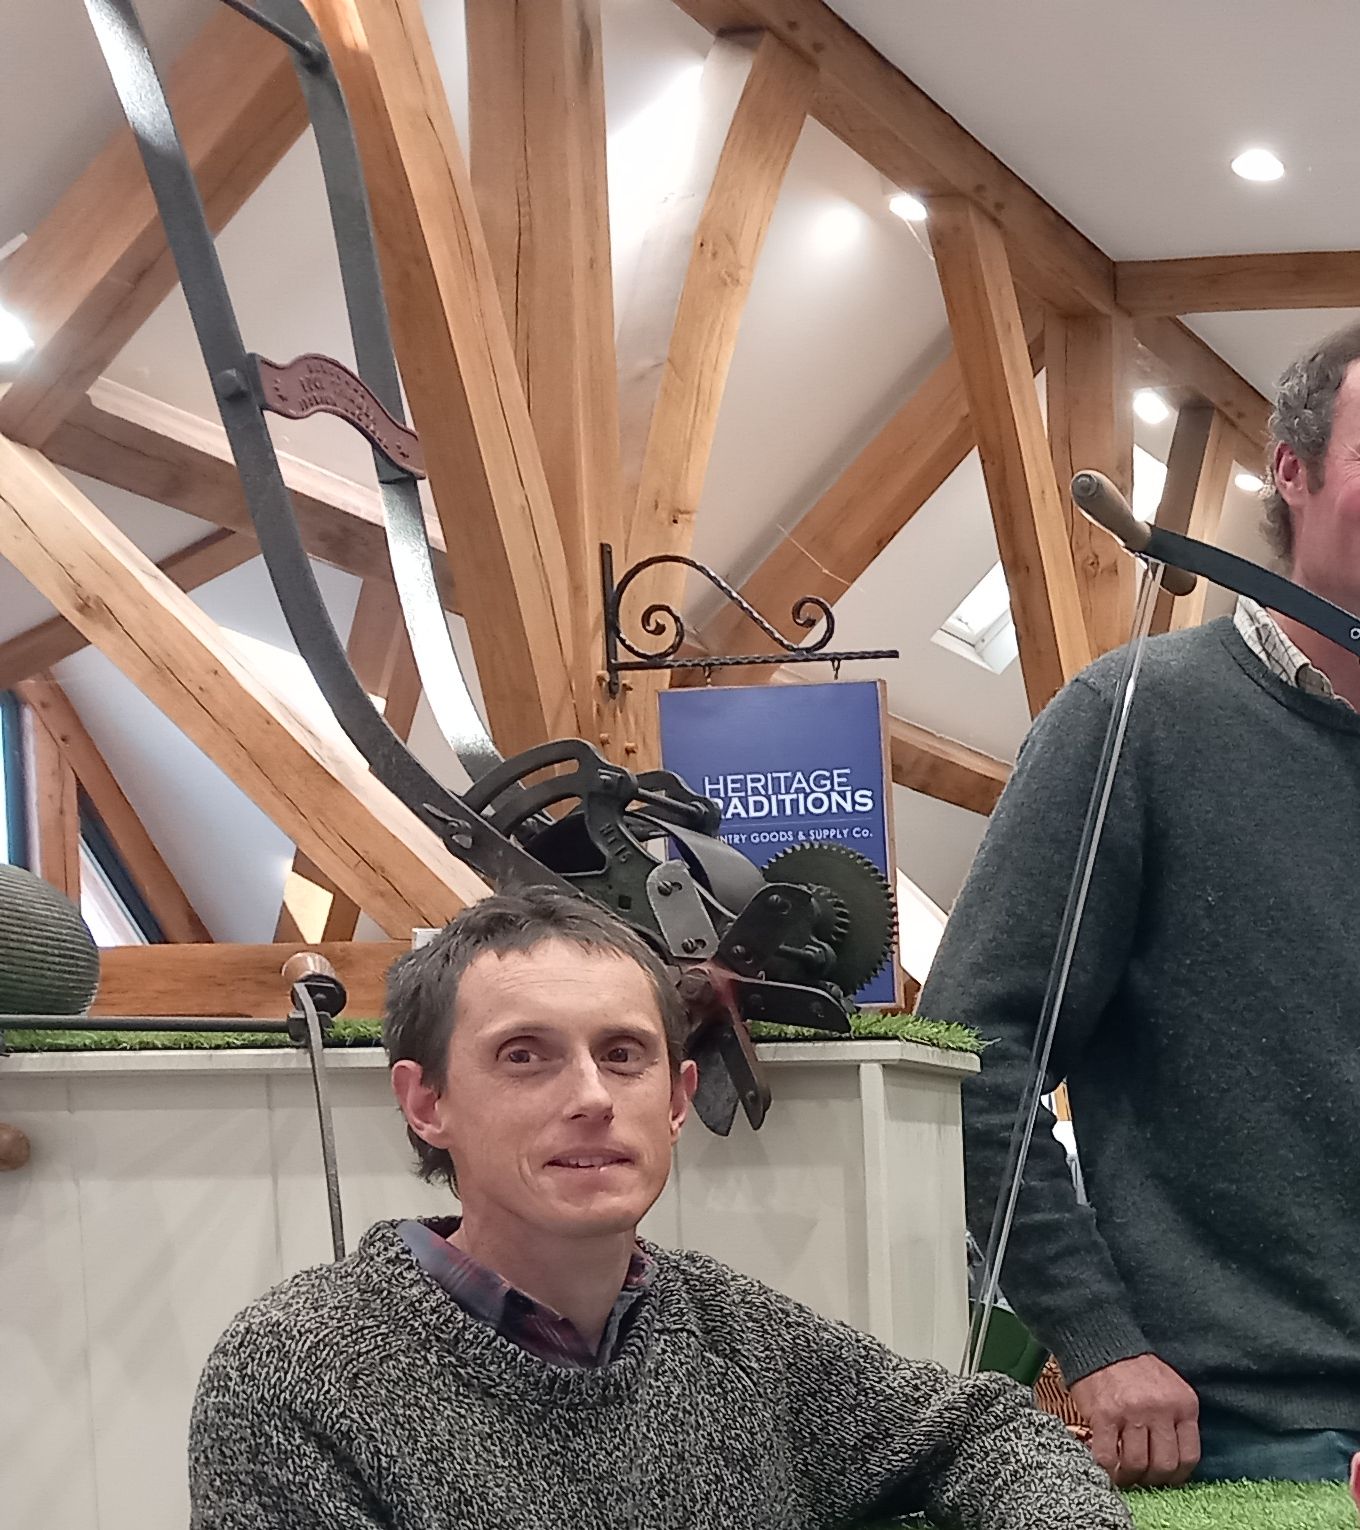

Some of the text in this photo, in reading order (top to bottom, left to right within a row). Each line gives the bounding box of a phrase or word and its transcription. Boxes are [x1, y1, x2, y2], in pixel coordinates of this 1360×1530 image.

[704, 768, 852, 798] HERITAGE
[710, 789, 874, 819] ADITIONS
[717, 833, 747, 845] NTRY
[750, 830, 794, 844] GOODS
[797, 830, 806, 842] &
[809, 827, 849, 841] SUPPLY
